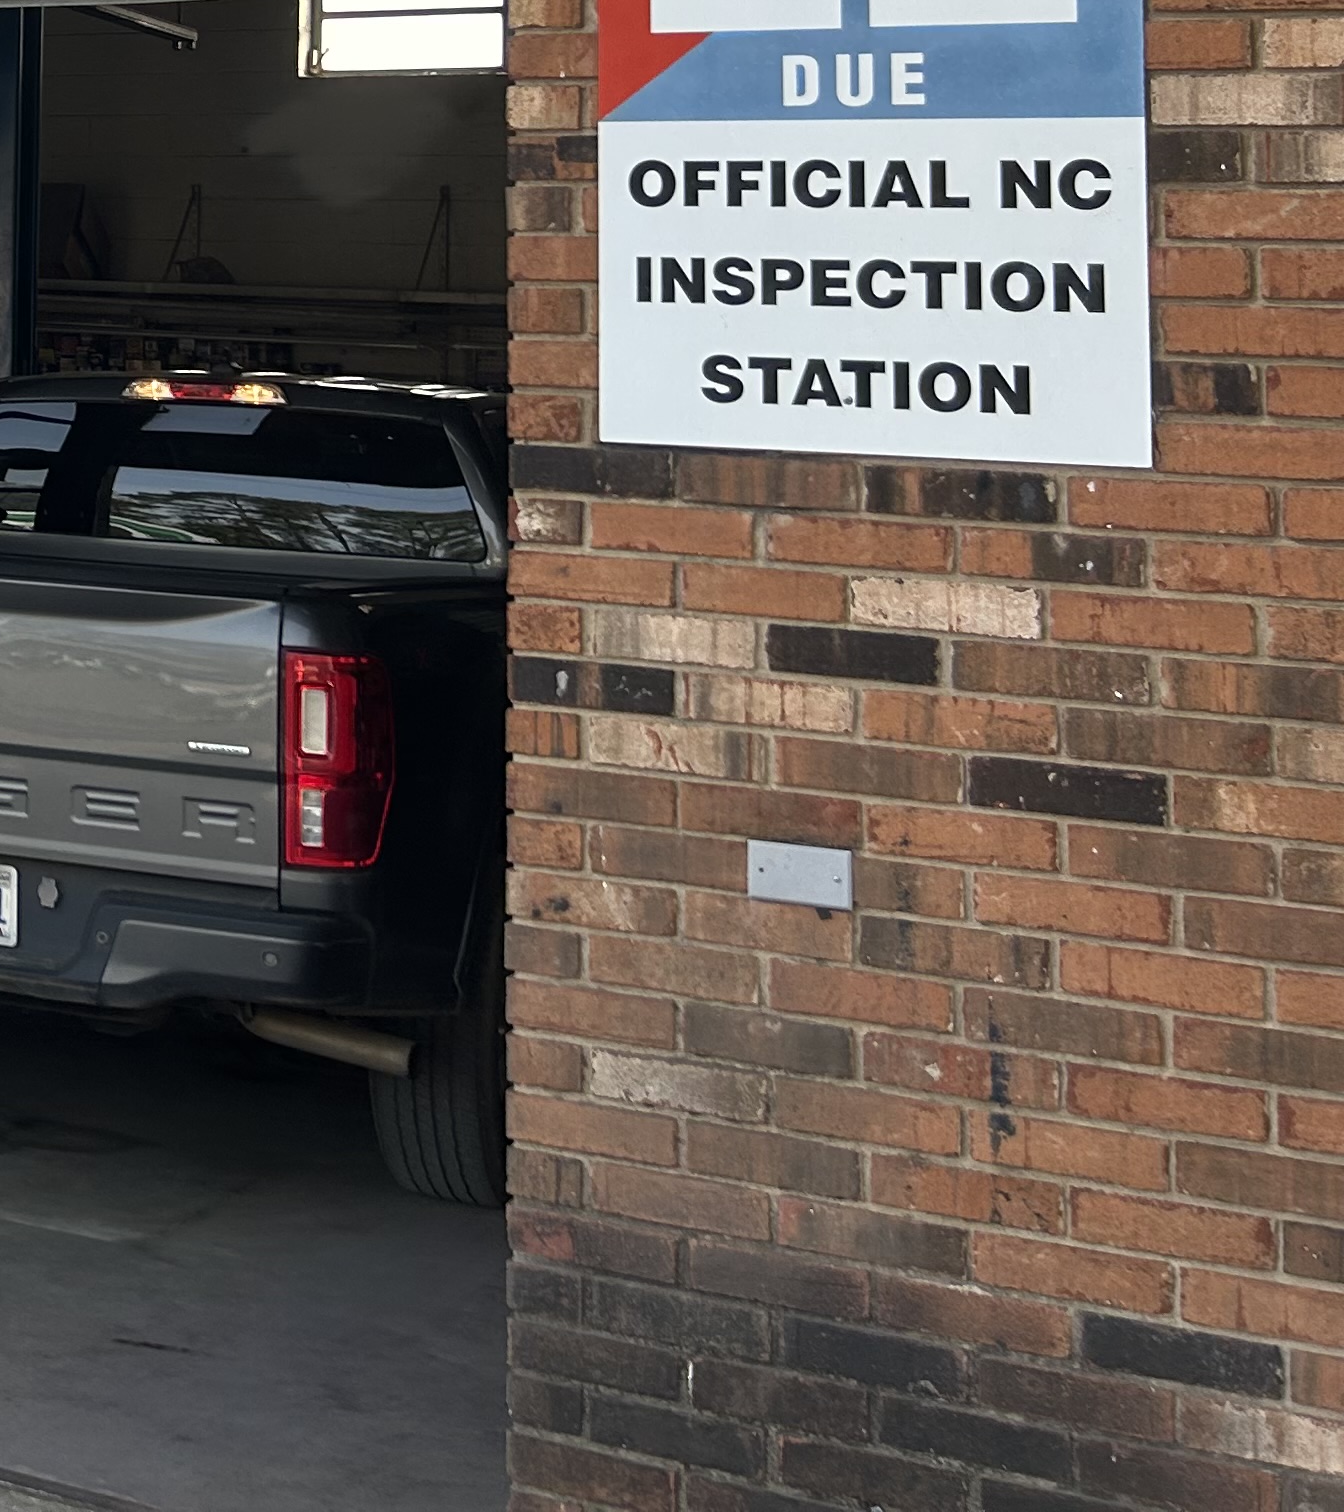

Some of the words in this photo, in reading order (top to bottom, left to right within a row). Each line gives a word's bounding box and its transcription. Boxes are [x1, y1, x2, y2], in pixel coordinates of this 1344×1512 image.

[782, 52, 926, 107] DUE
[628, 158, 971, 209] OFFICIAL
[999, 158, 1114, 211] NC
[635, 256, 1107, 314] INSPECTION
[700, 354, 1032, 416] STATION
